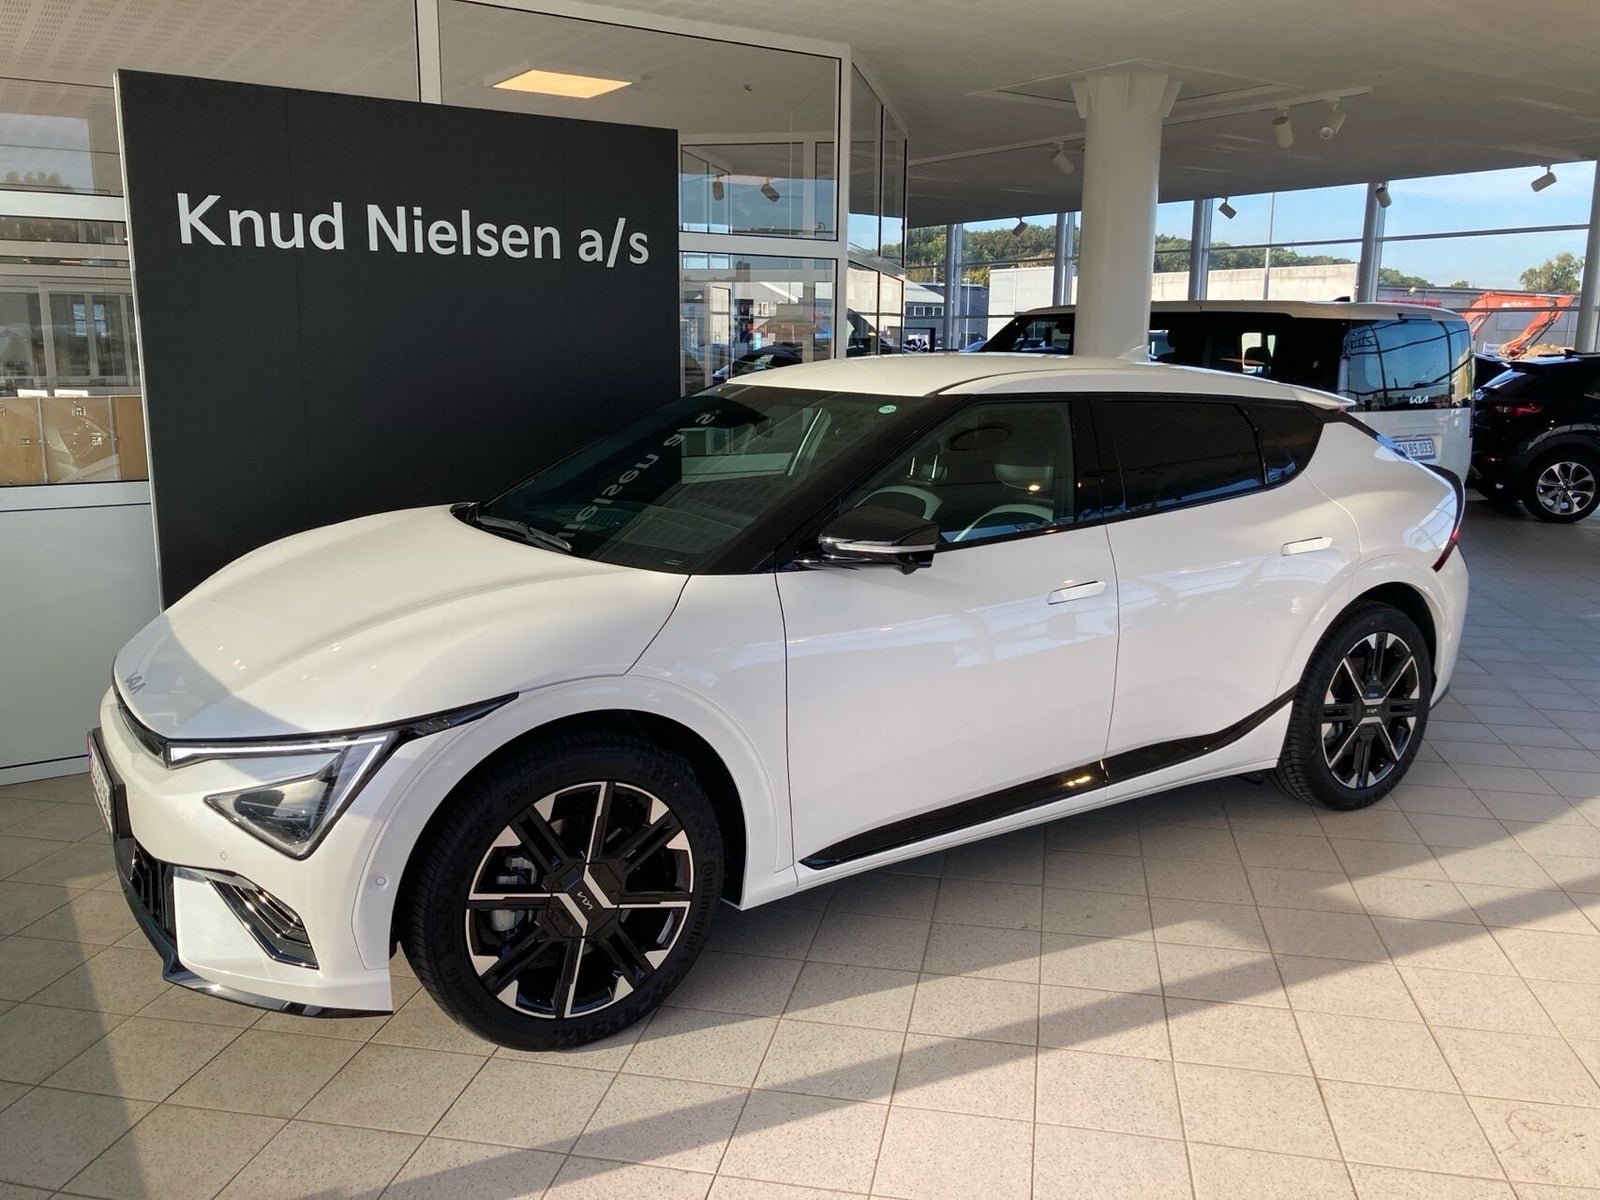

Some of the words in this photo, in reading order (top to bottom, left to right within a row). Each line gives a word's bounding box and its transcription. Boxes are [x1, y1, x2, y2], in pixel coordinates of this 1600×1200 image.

[177, 192, 345, 250] Knud
[366, 204, 561, 260] Nielsen
[578, 217, 649, 268] a/s
[1409, 395, 1429, 405] KIA
[1408, 443, 1418, 455] 85
[1419, 441, 1433, 454] 033
